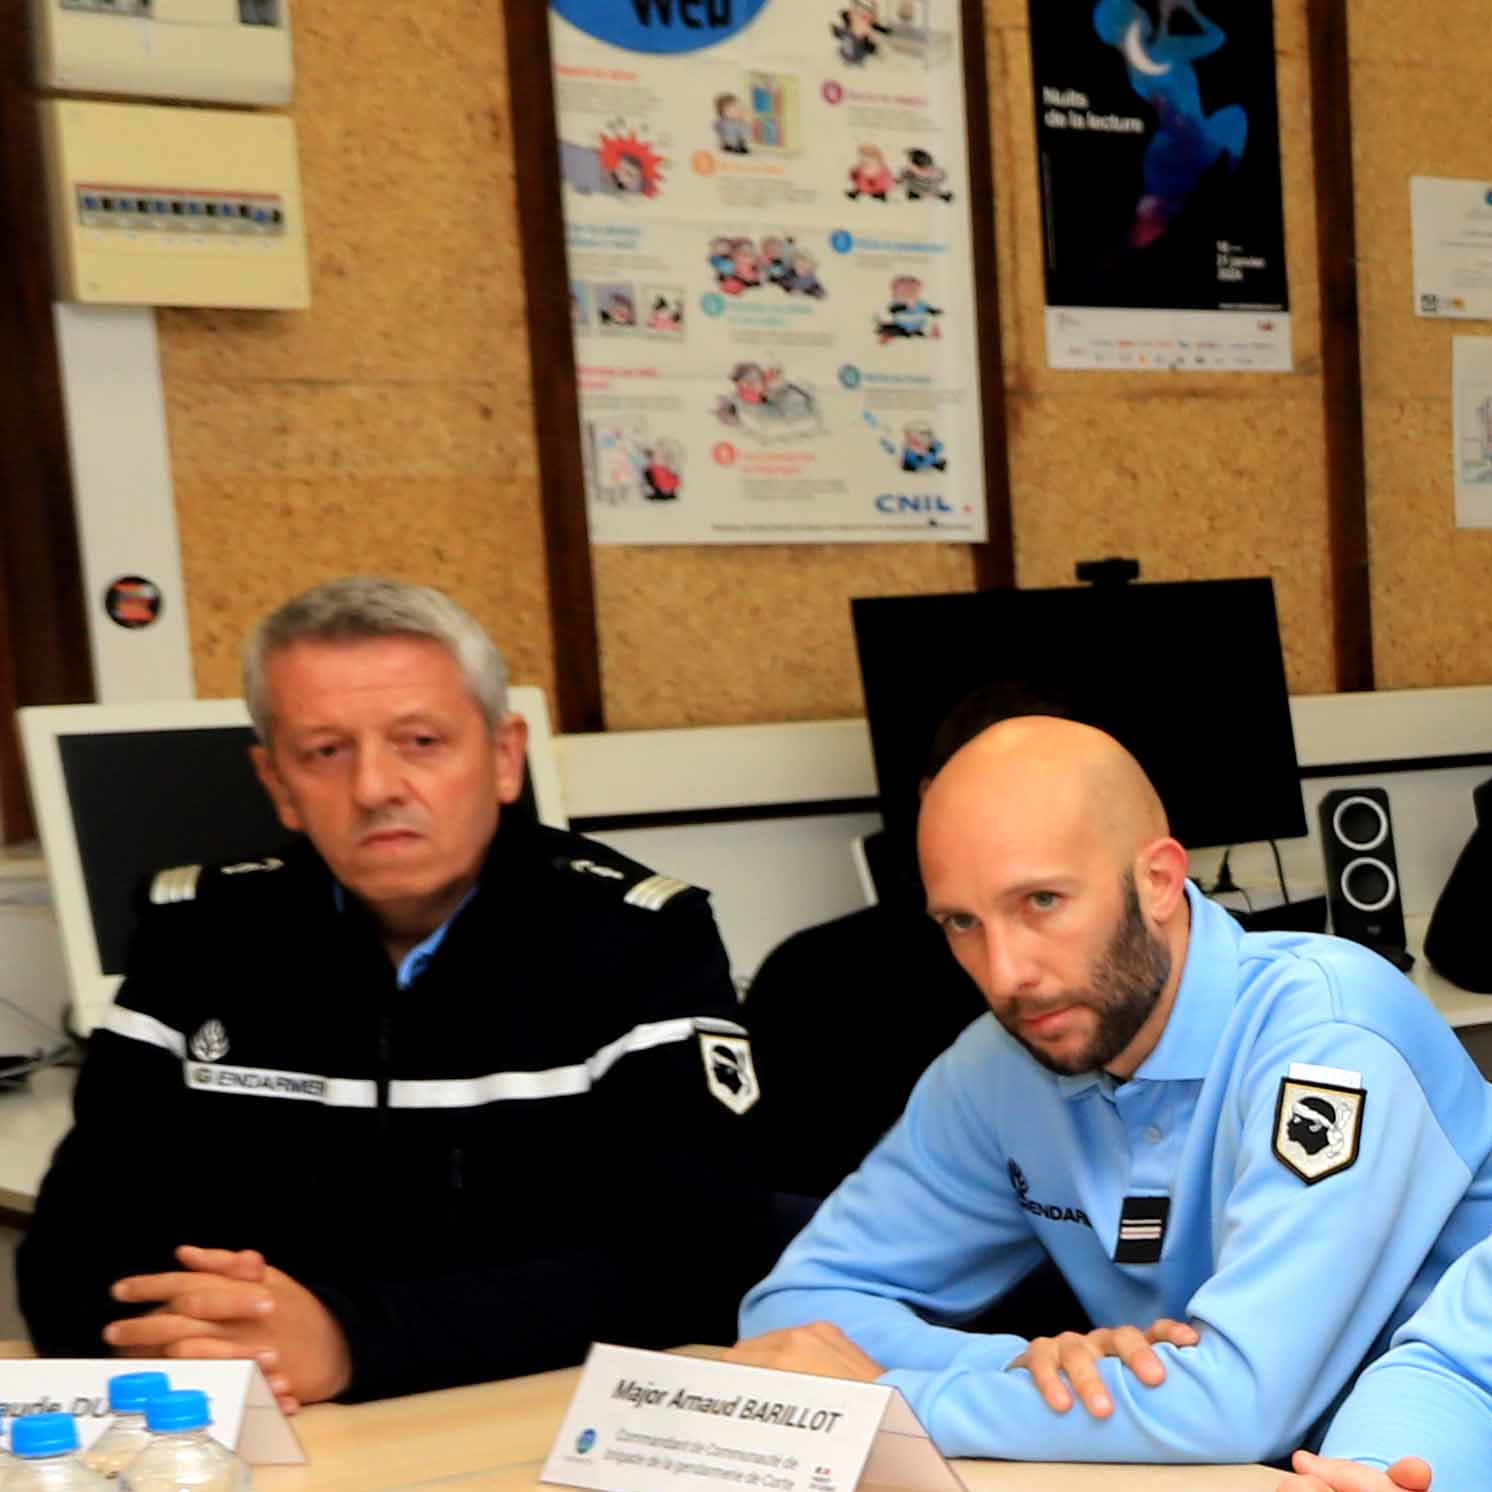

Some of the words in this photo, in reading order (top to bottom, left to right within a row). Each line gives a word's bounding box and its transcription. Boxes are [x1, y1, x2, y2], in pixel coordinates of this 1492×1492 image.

[874, 494, 952, 513] CNIL
[612, 1378, 667, 1408] Major
[669, 1388, 740, 1418] Arnaud
[740, 1397, 843, 1433] BARILLOT
